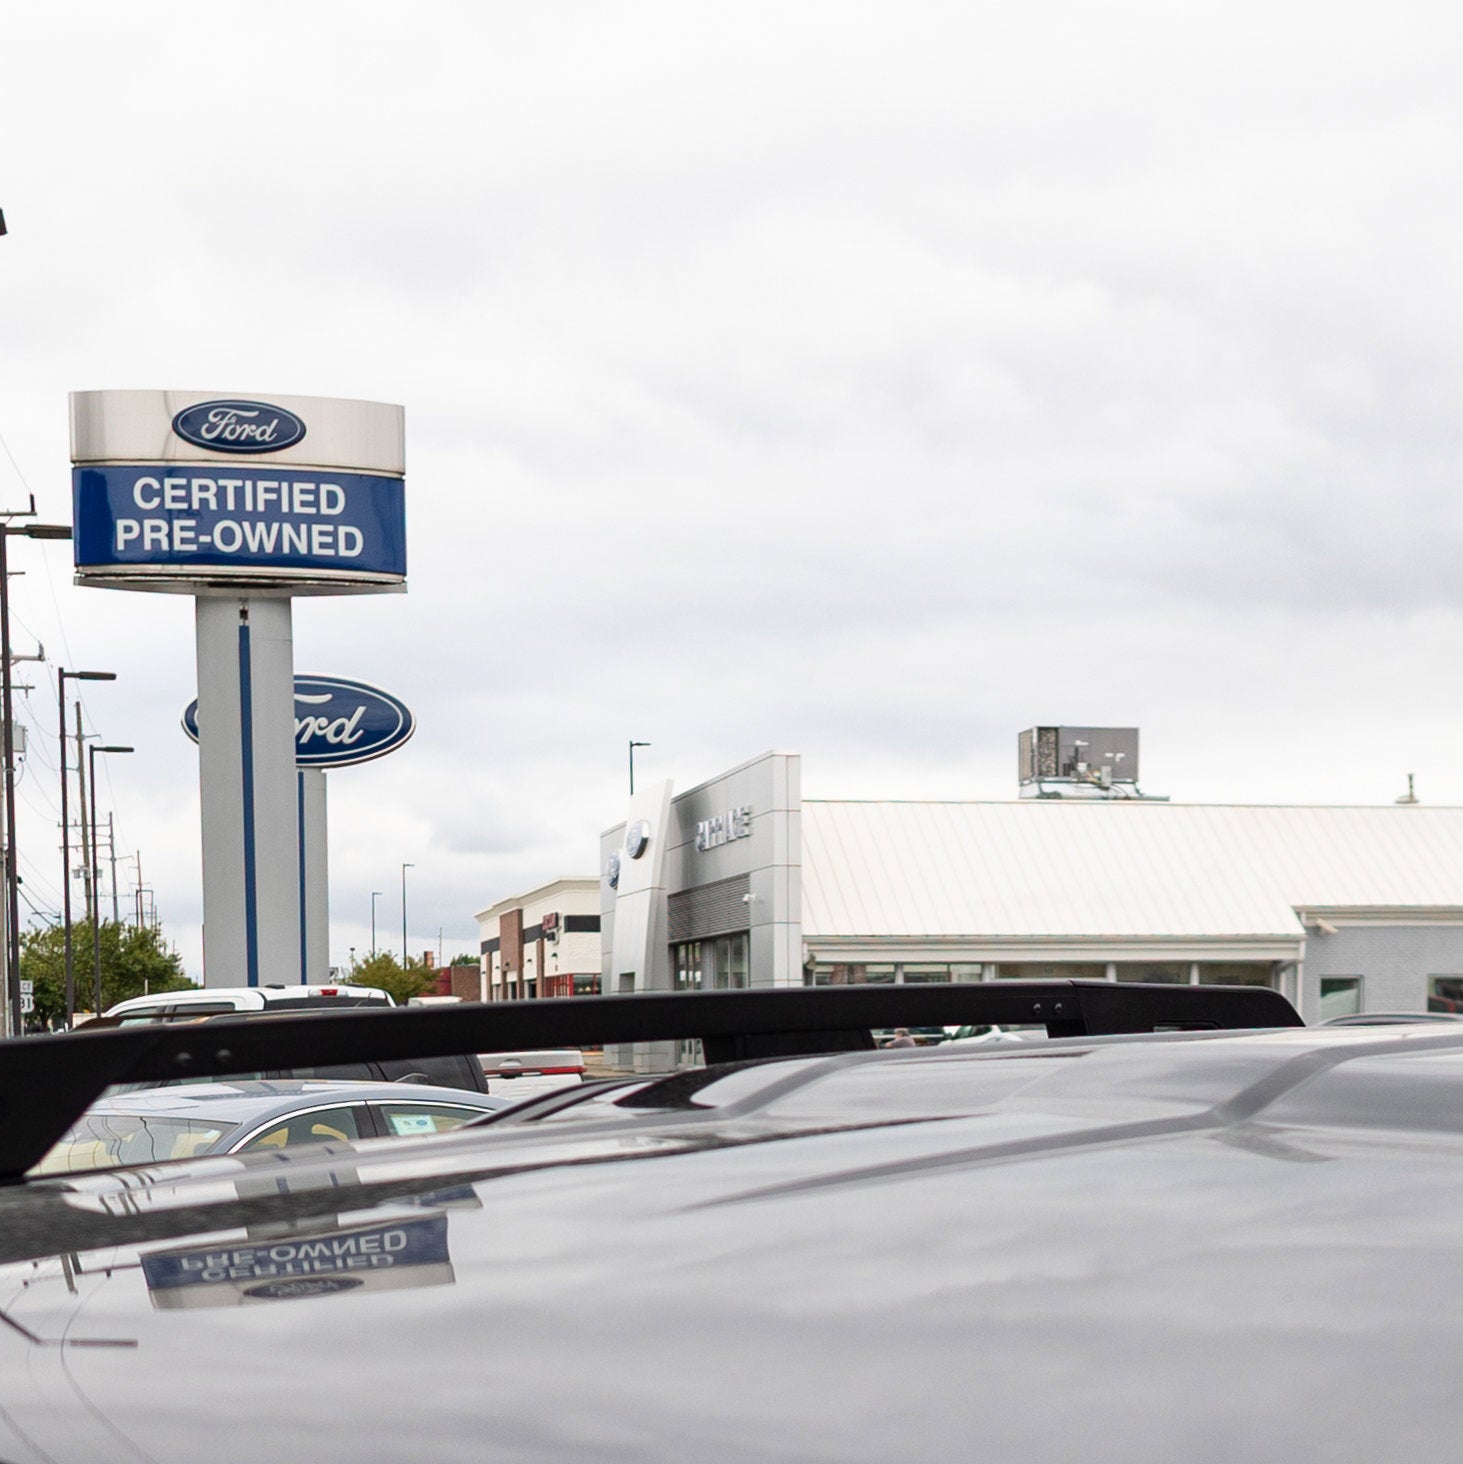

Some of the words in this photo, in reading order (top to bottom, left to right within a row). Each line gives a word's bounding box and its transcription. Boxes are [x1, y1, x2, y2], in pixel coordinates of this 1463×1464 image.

[201, 407, 280, 443] Ford
[132, 476, 347, 517] CERTIFIED
[115, 518, 365, 558] PRE-OWNED
